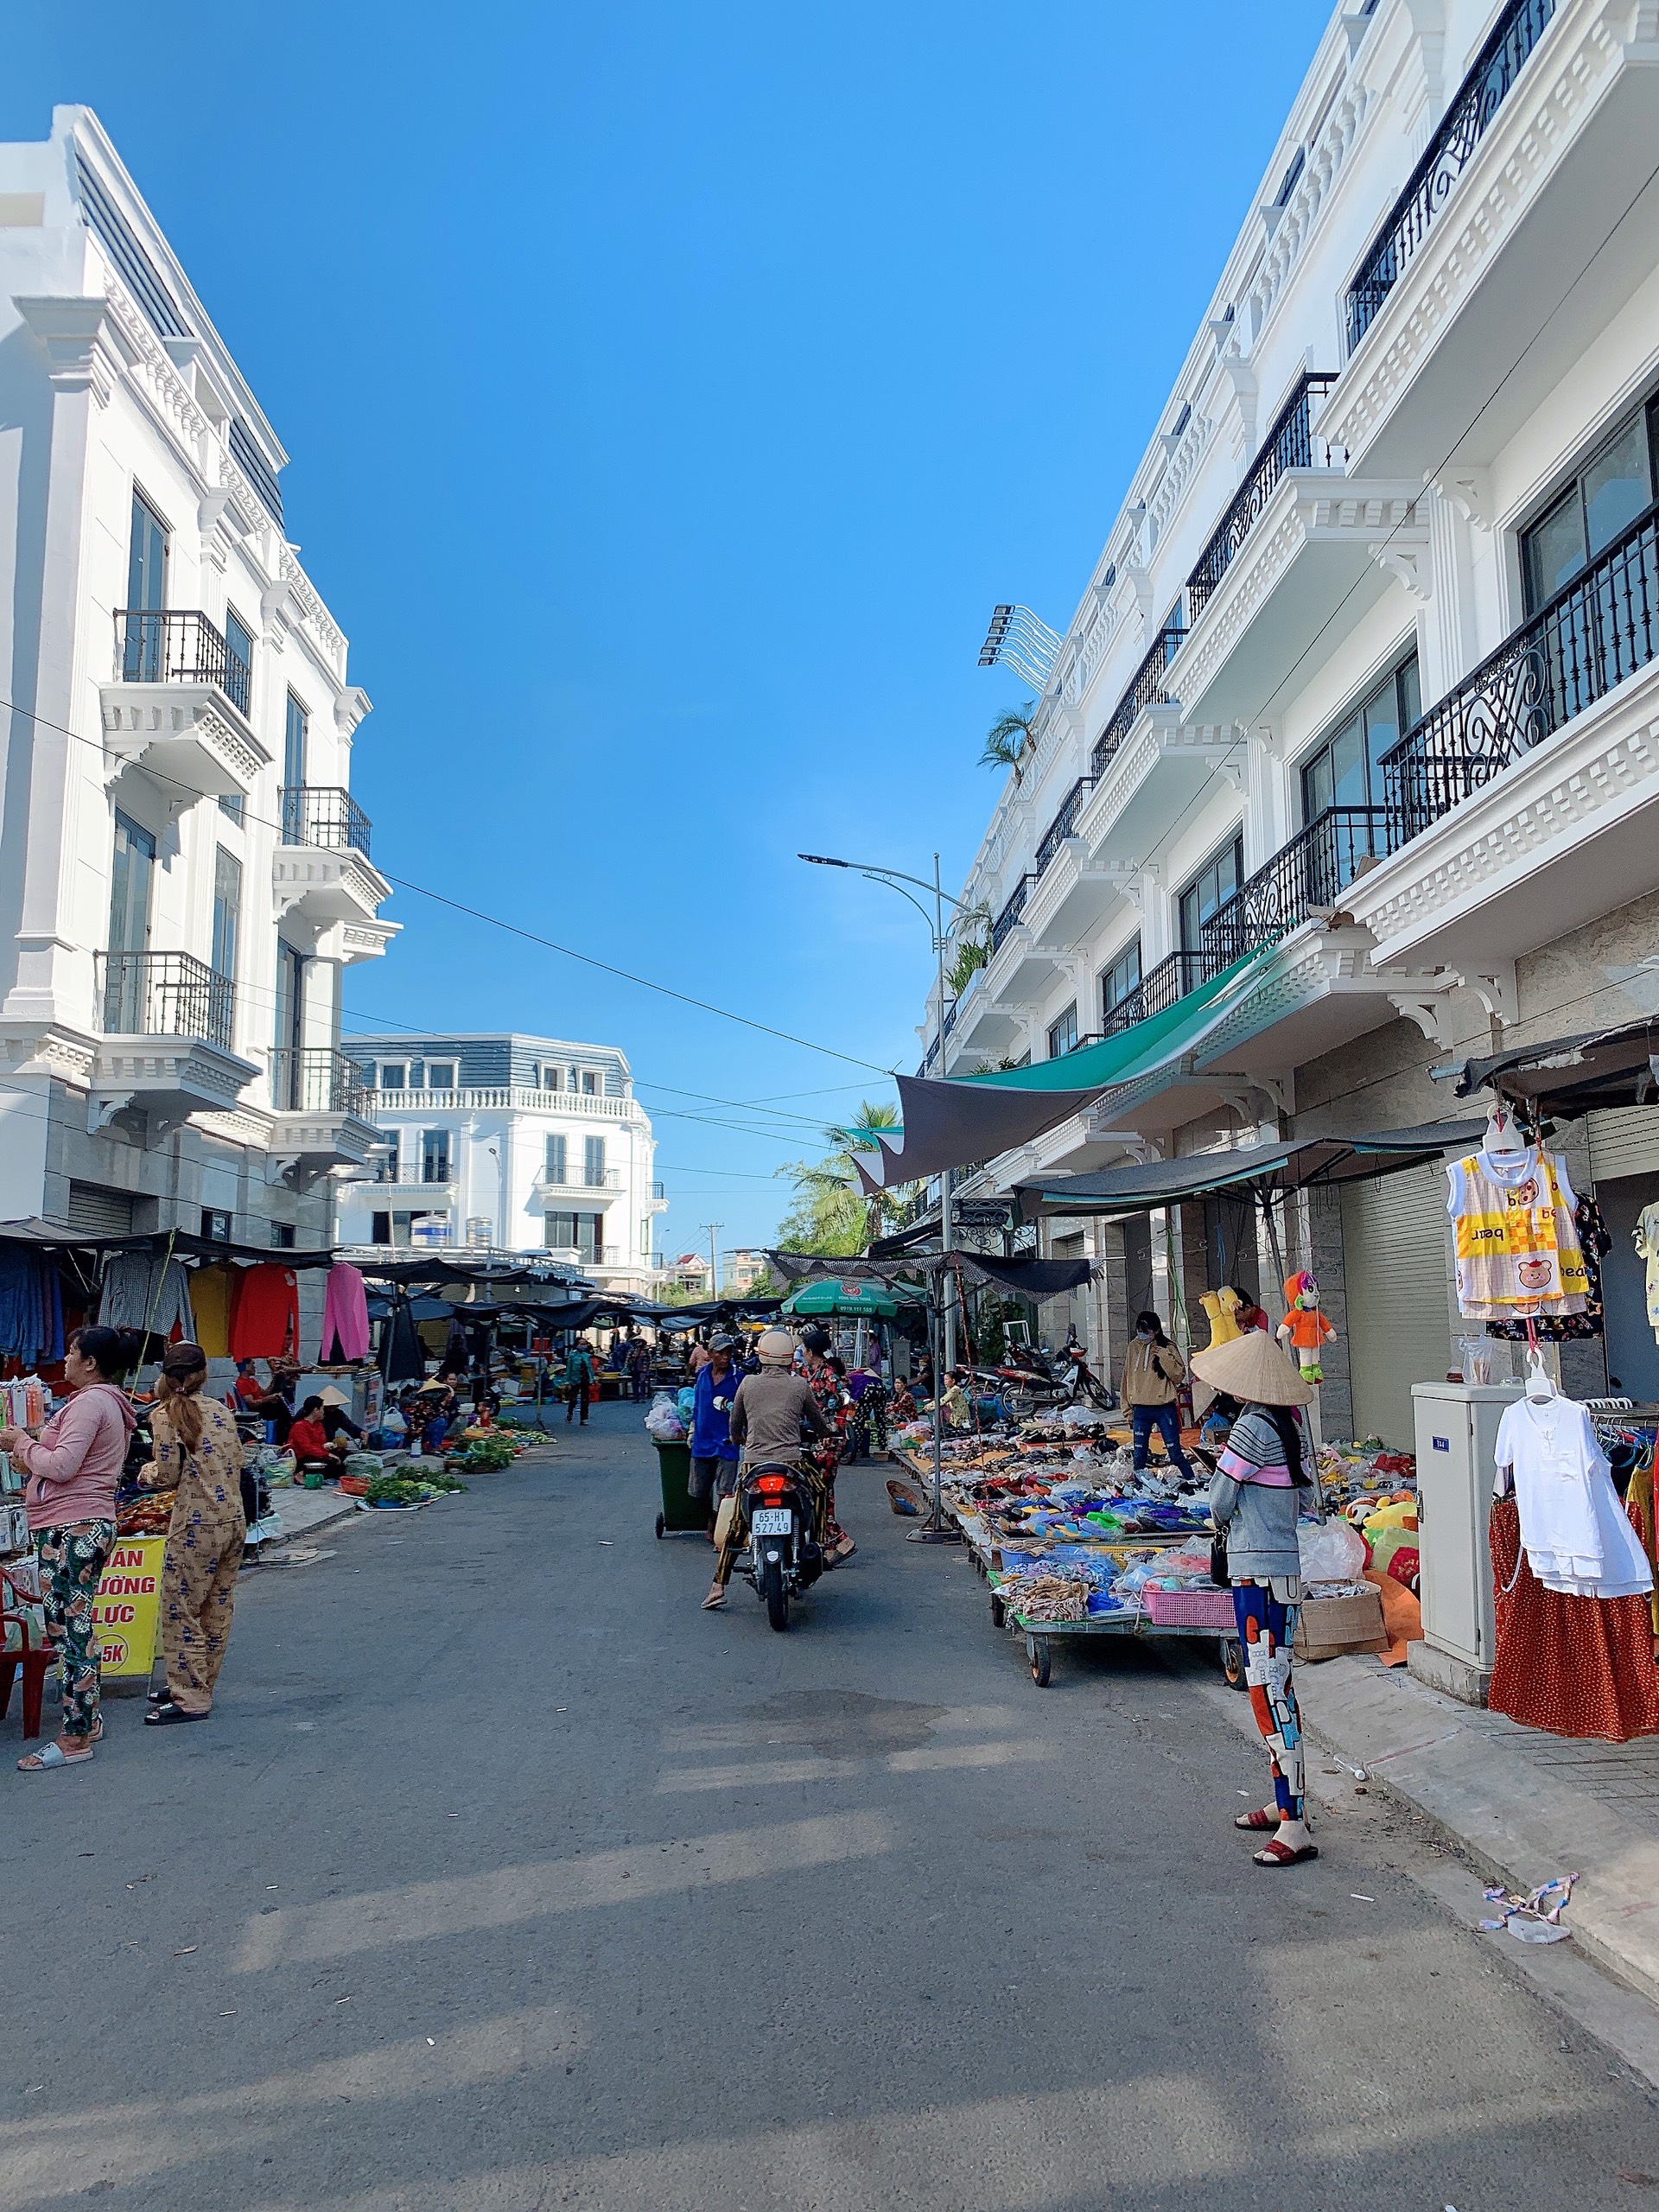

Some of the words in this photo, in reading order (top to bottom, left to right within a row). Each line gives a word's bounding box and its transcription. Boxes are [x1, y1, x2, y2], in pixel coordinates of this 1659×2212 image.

[1471, 1228, 1503, 1241] bear
[759, 1512, 785, 1522] 65-H1
[755, 1522, 789, 1534] 527.49
